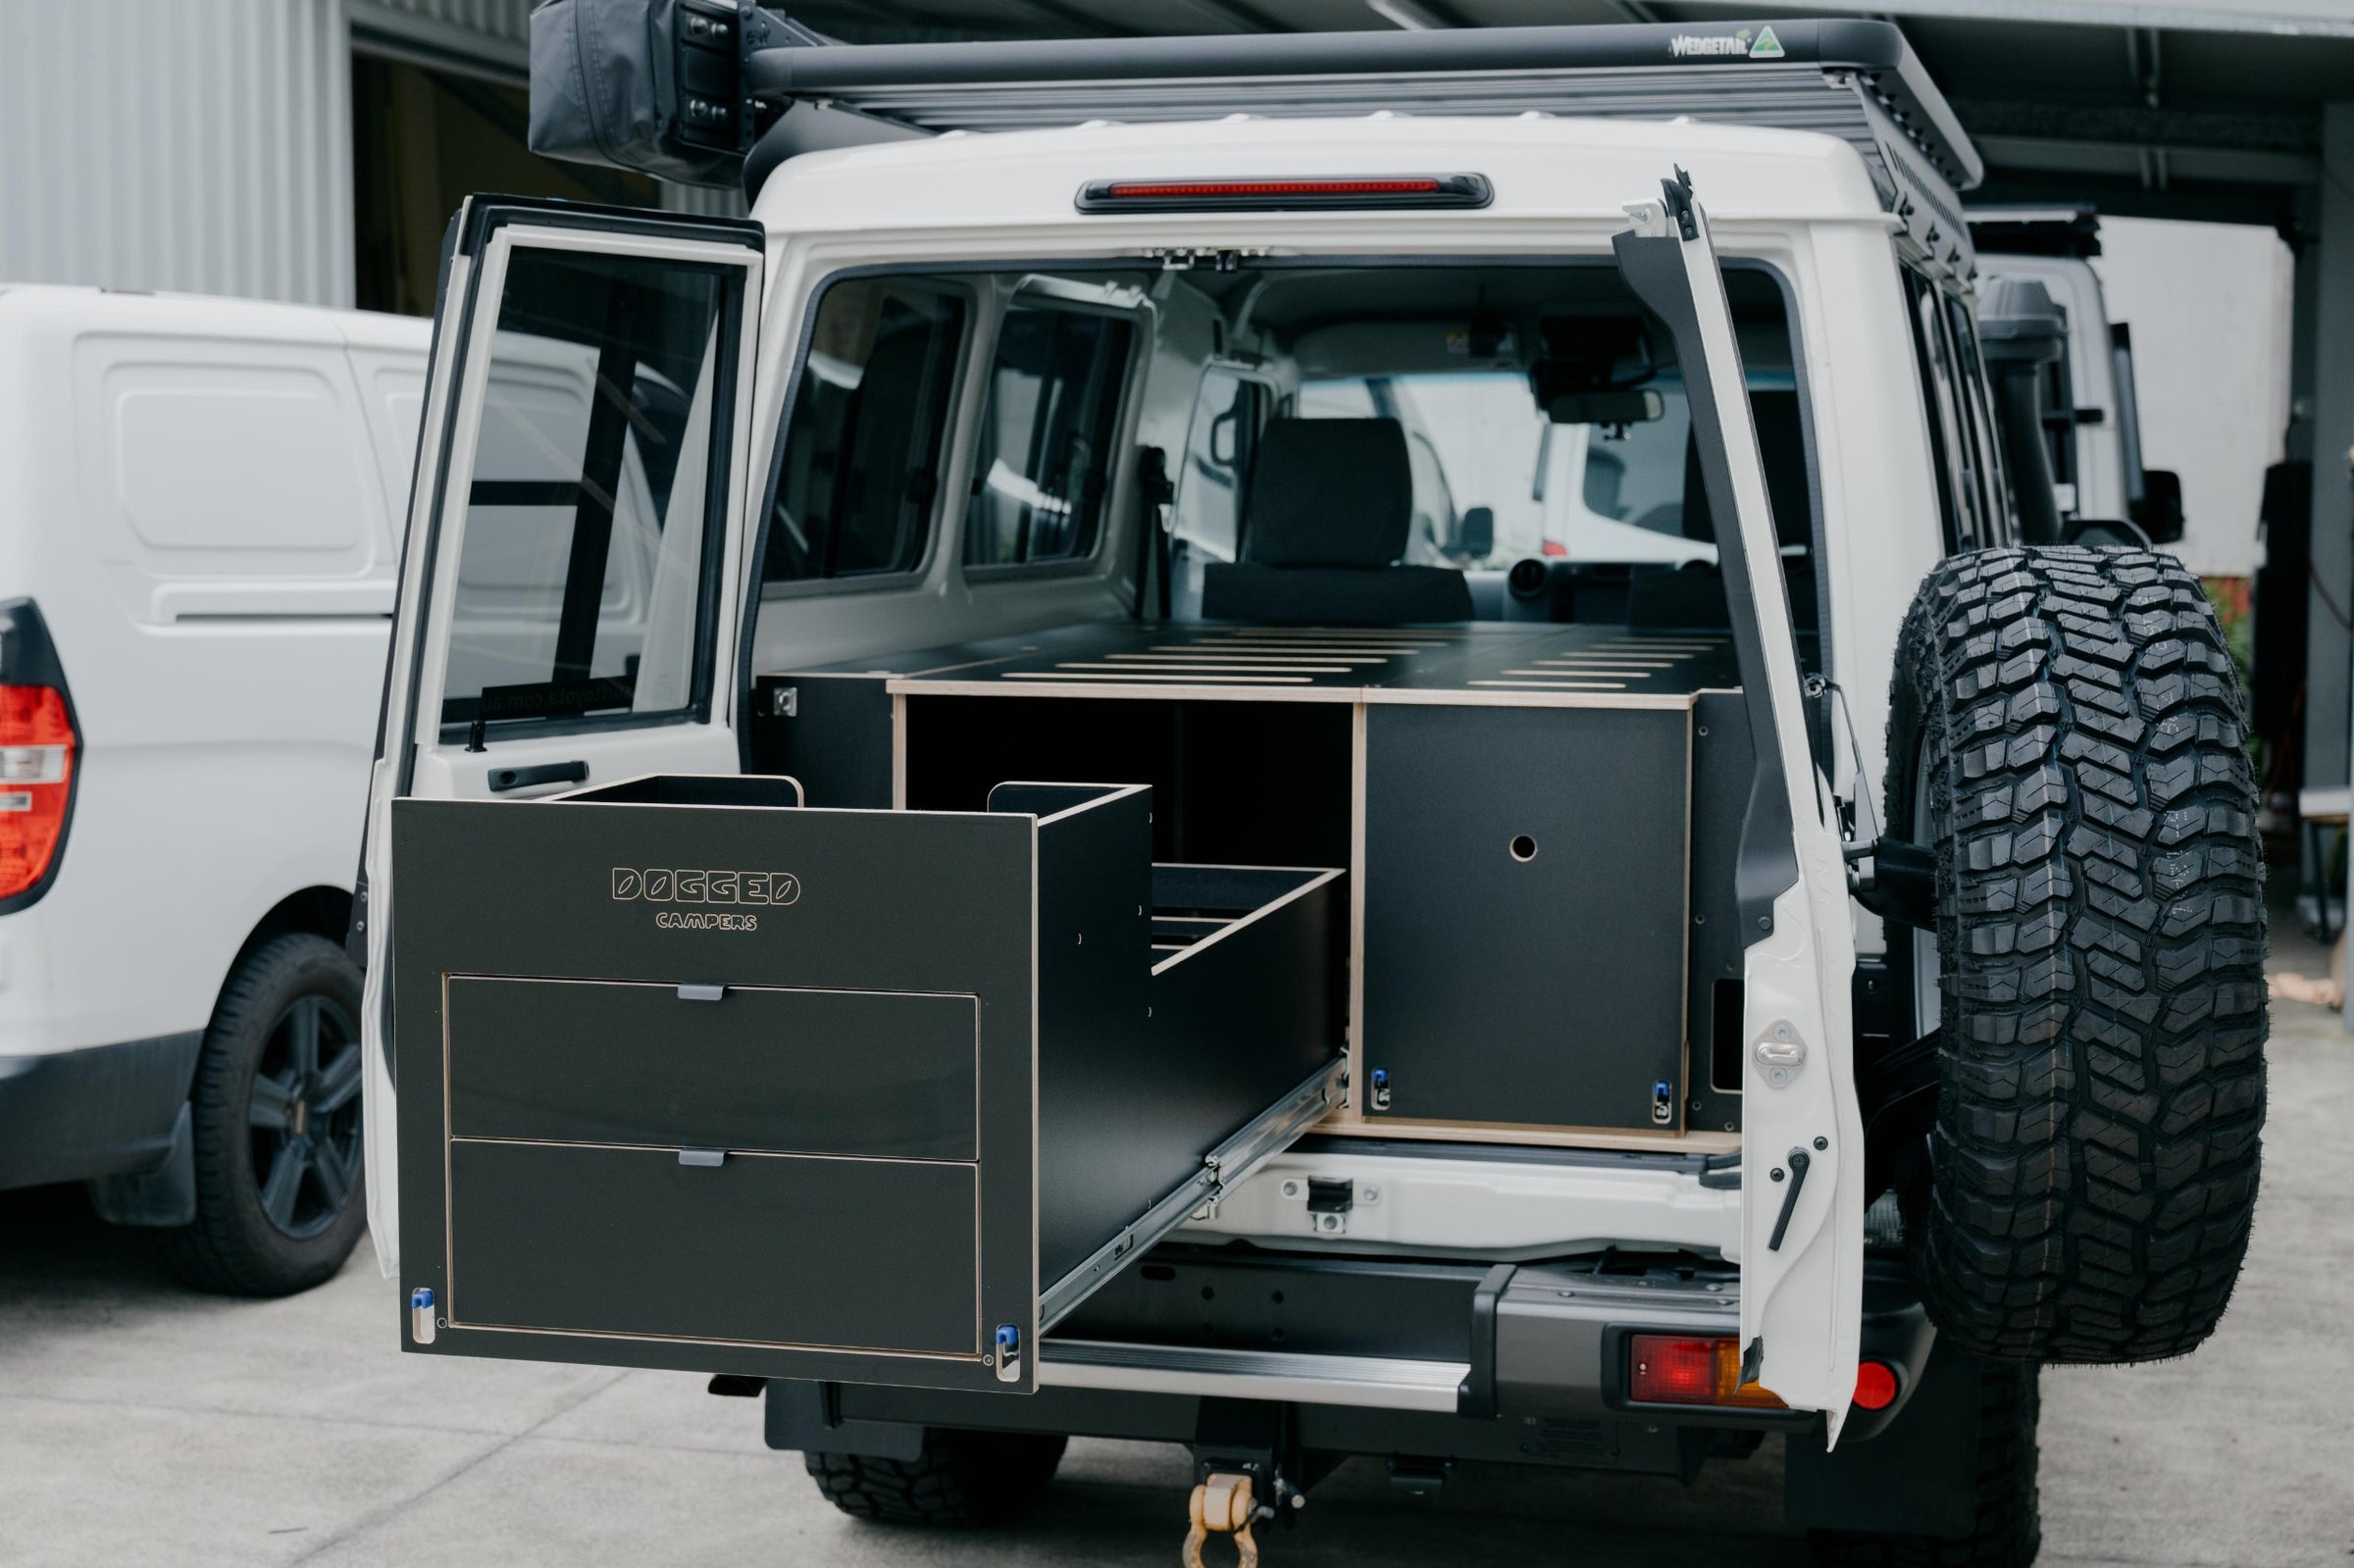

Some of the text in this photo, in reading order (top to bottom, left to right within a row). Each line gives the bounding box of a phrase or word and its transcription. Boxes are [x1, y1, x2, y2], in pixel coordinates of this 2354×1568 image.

[1670, 34, 1749, 58] WEDGETAIL
[612, 867, 801, 905] DOGGED
[655, 912, 757, 932] CAMPERS
